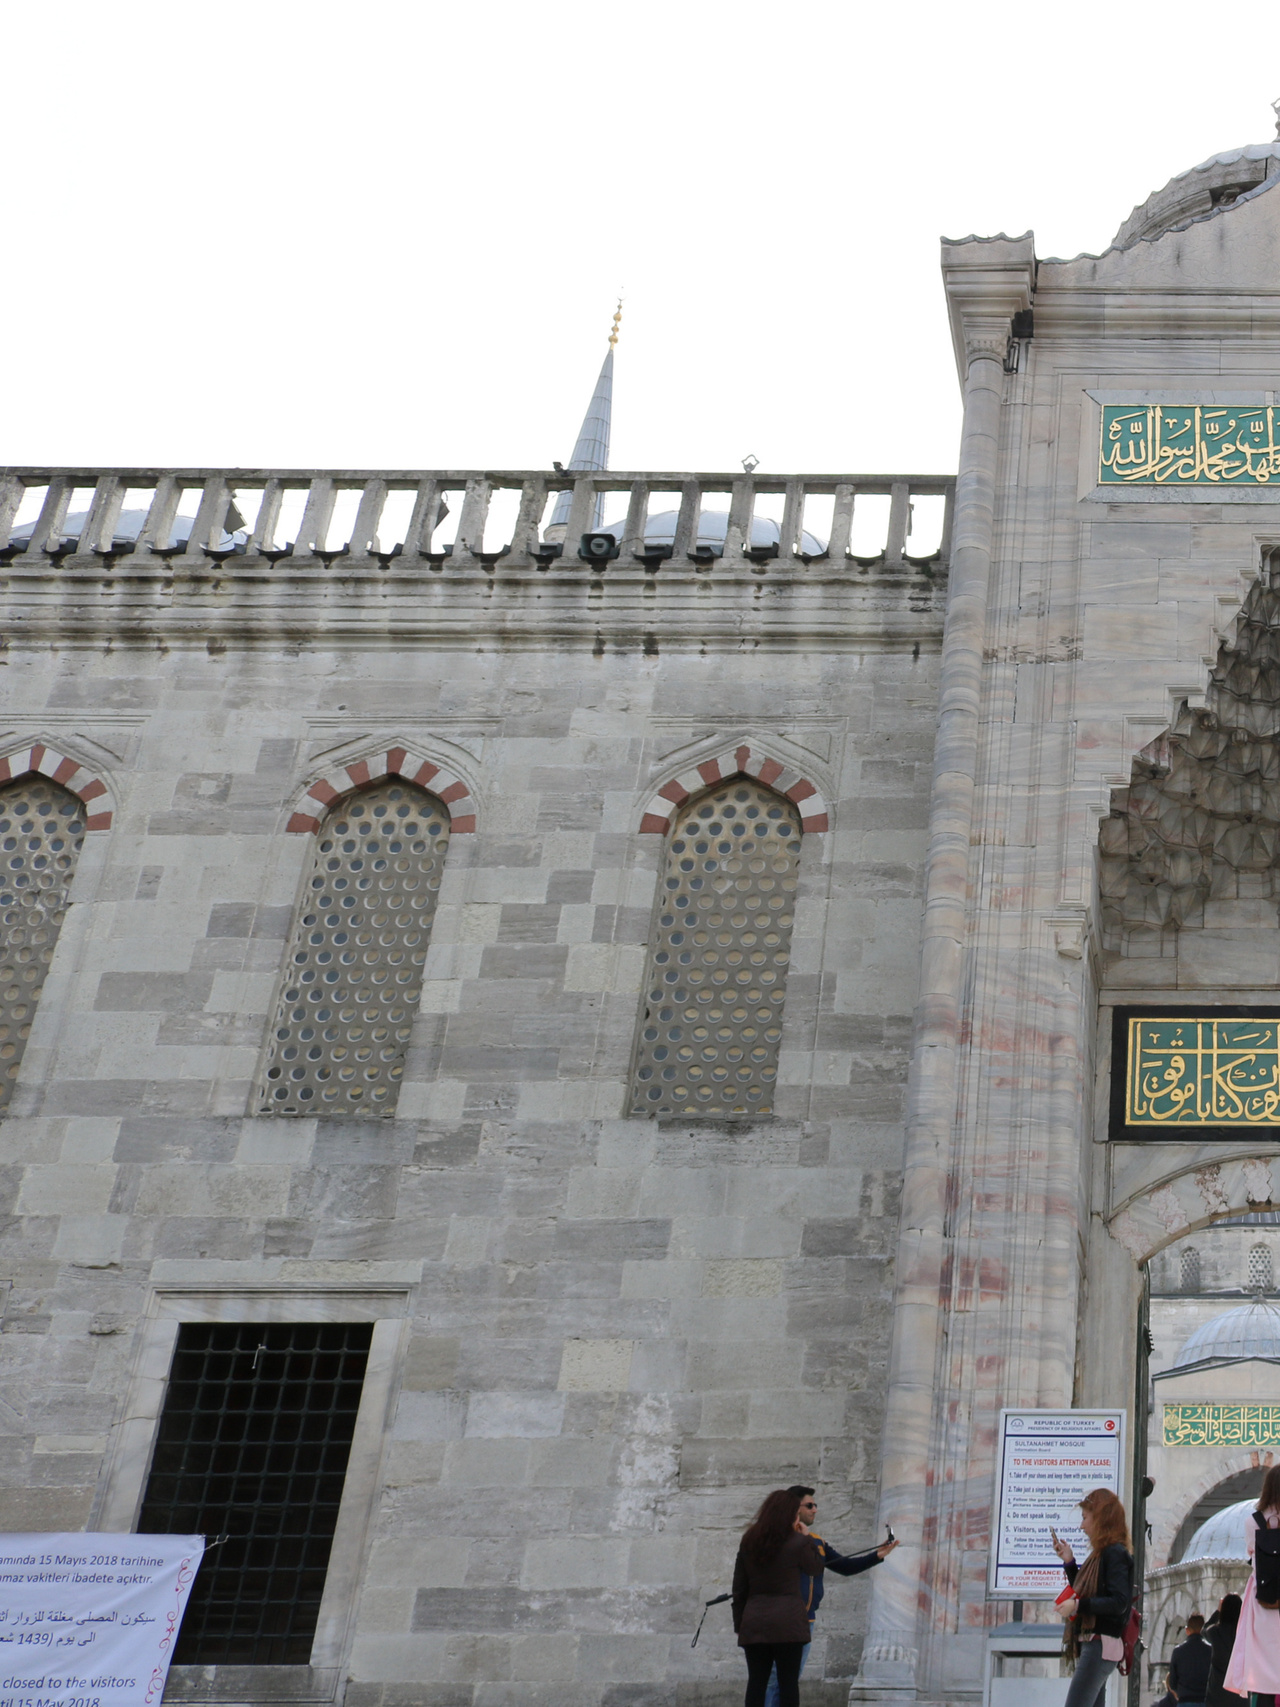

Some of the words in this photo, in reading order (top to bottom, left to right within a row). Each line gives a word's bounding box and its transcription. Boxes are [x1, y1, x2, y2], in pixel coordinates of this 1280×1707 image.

[39, 1555, 52, 1565] 15
[55, 1556, 87, 1567] Mayıs
[90, 1556, 118, 1566] 2018
[121, 1556, 164, 1567] tarihine
[27, 1572, 70, 1584] vakitleri
[72, 1573, 113, 1584] ibadete
[3, 1676, 45, 1689] closed
[48, 1678, 62, 1688] to
[66, 1677, 86, 1688] the
[90, 1676, 136, 1688] visitors
